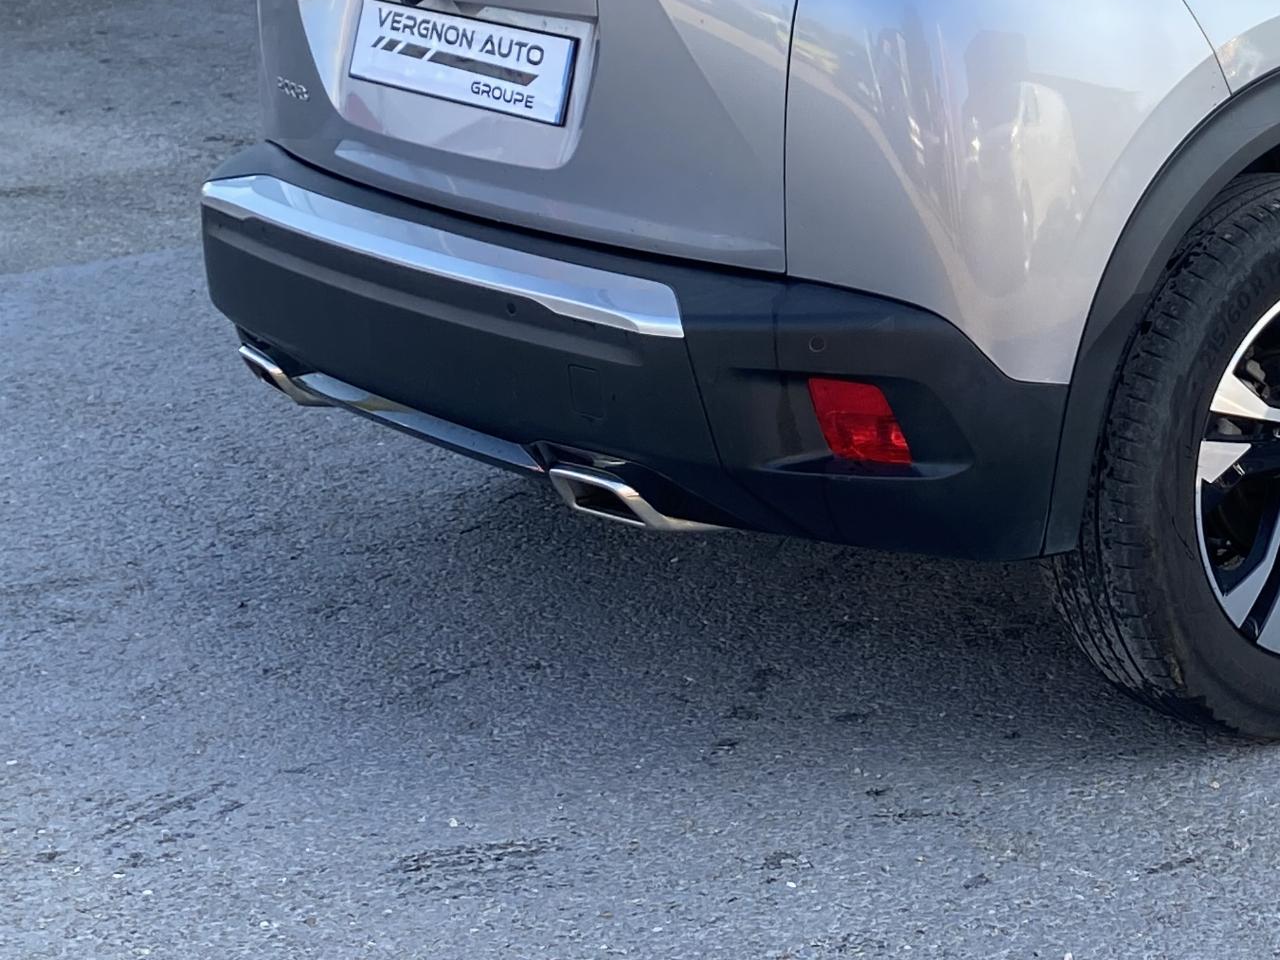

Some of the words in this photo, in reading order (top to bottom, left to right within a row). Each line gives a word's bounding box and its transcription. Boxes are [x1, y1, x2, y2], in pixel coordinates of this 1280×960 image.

[378, 7, 475, 51] VERGNON
[480, 33, 545, 66] AUTO
[470, 80, 535, 110] GROUPE
